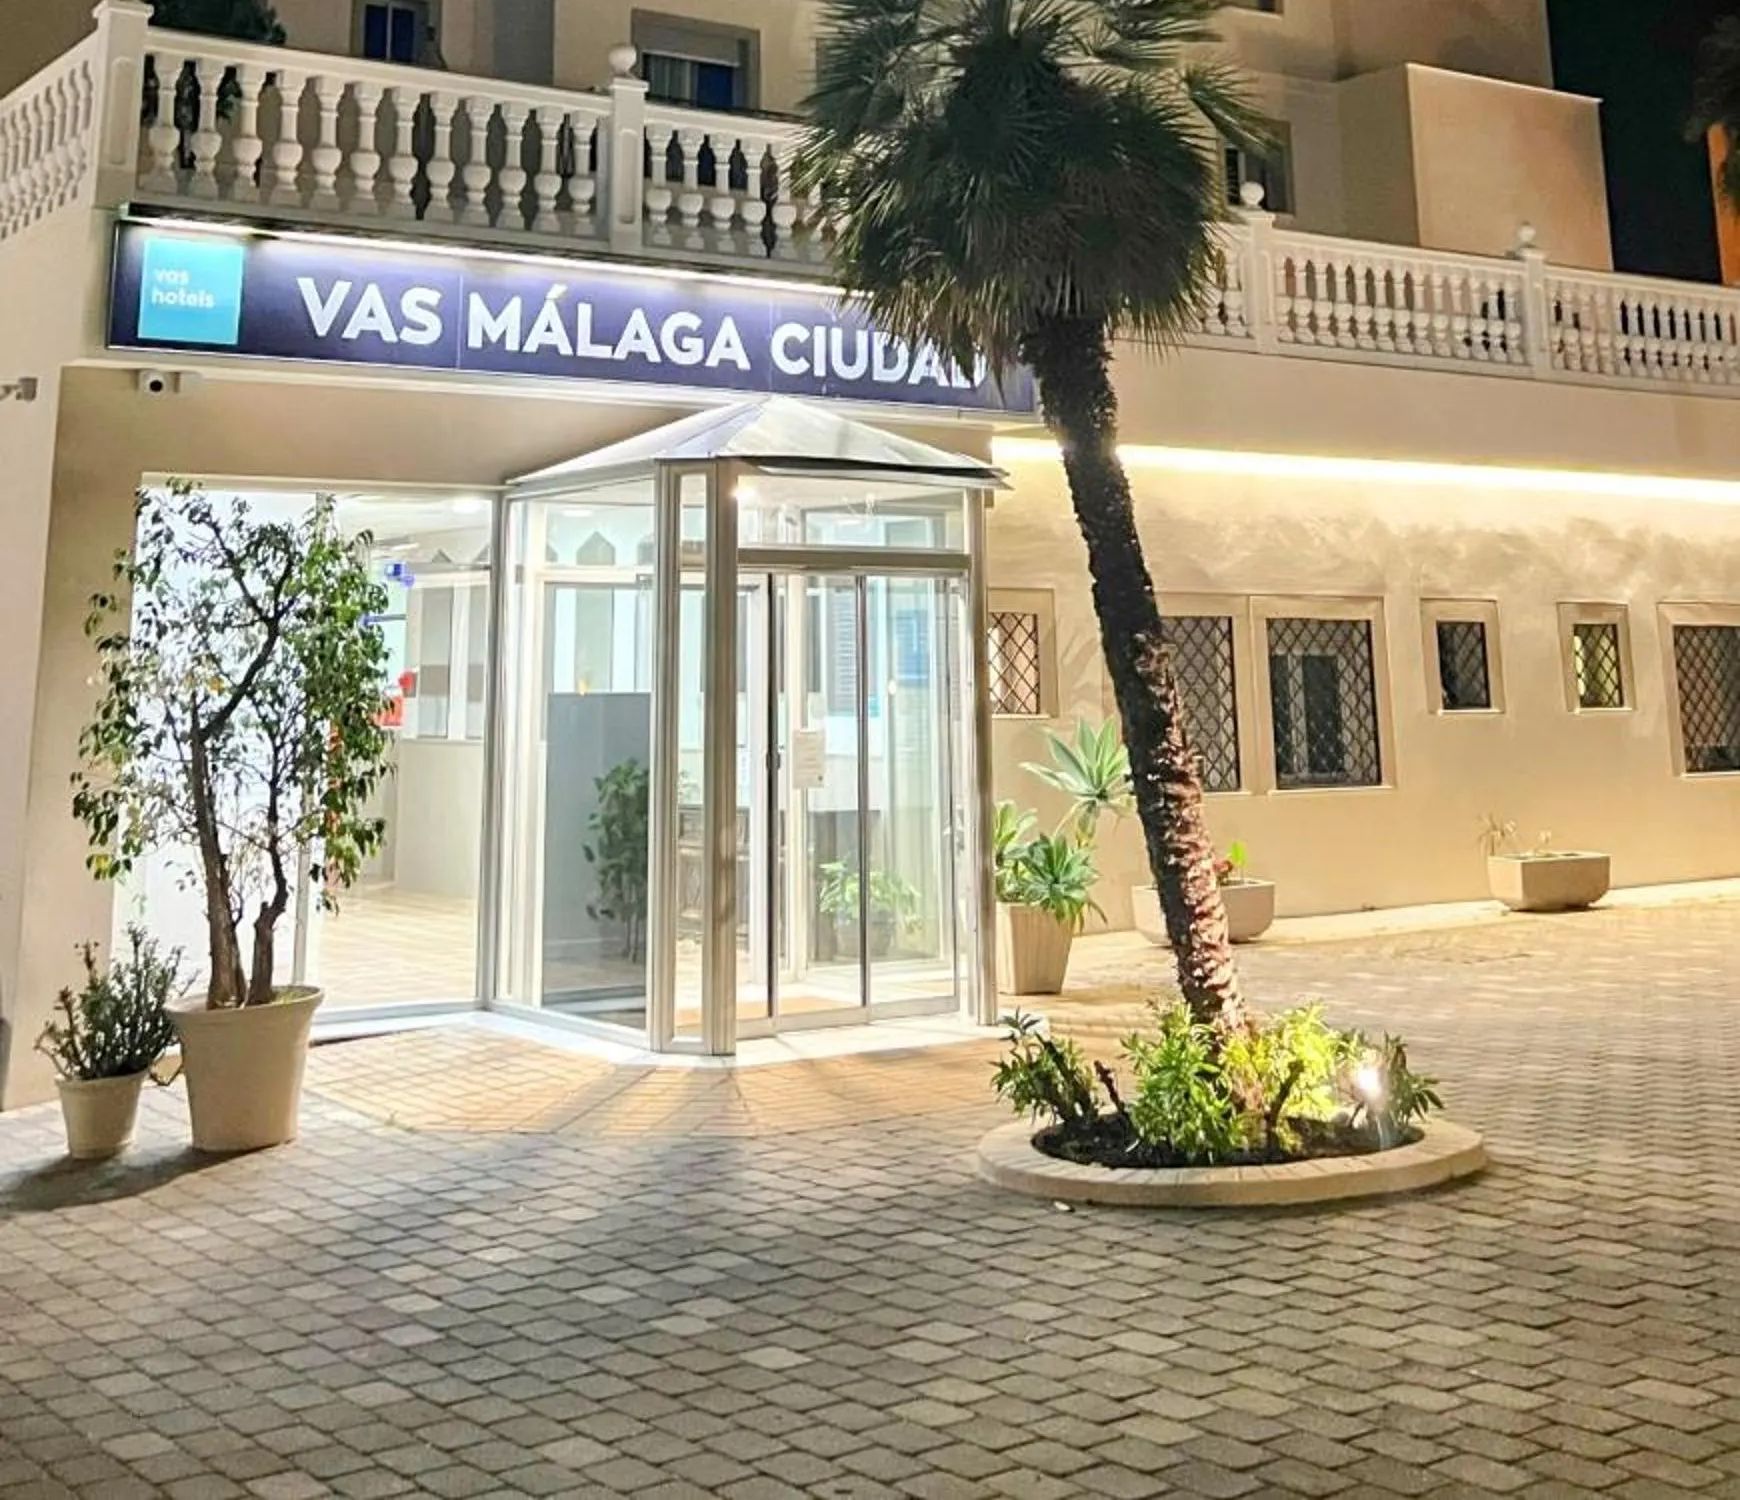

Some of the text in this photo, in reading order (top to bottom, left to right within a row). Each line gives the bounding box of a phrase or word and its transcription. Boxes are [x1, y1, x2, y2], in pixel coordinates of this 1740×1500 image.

[152, 268, 190, 286] vas
[151, 287, 216, 309] hotels
[297, 276, 443, 346] VAS
[467, 284, 750, 371] MÁLAGA
